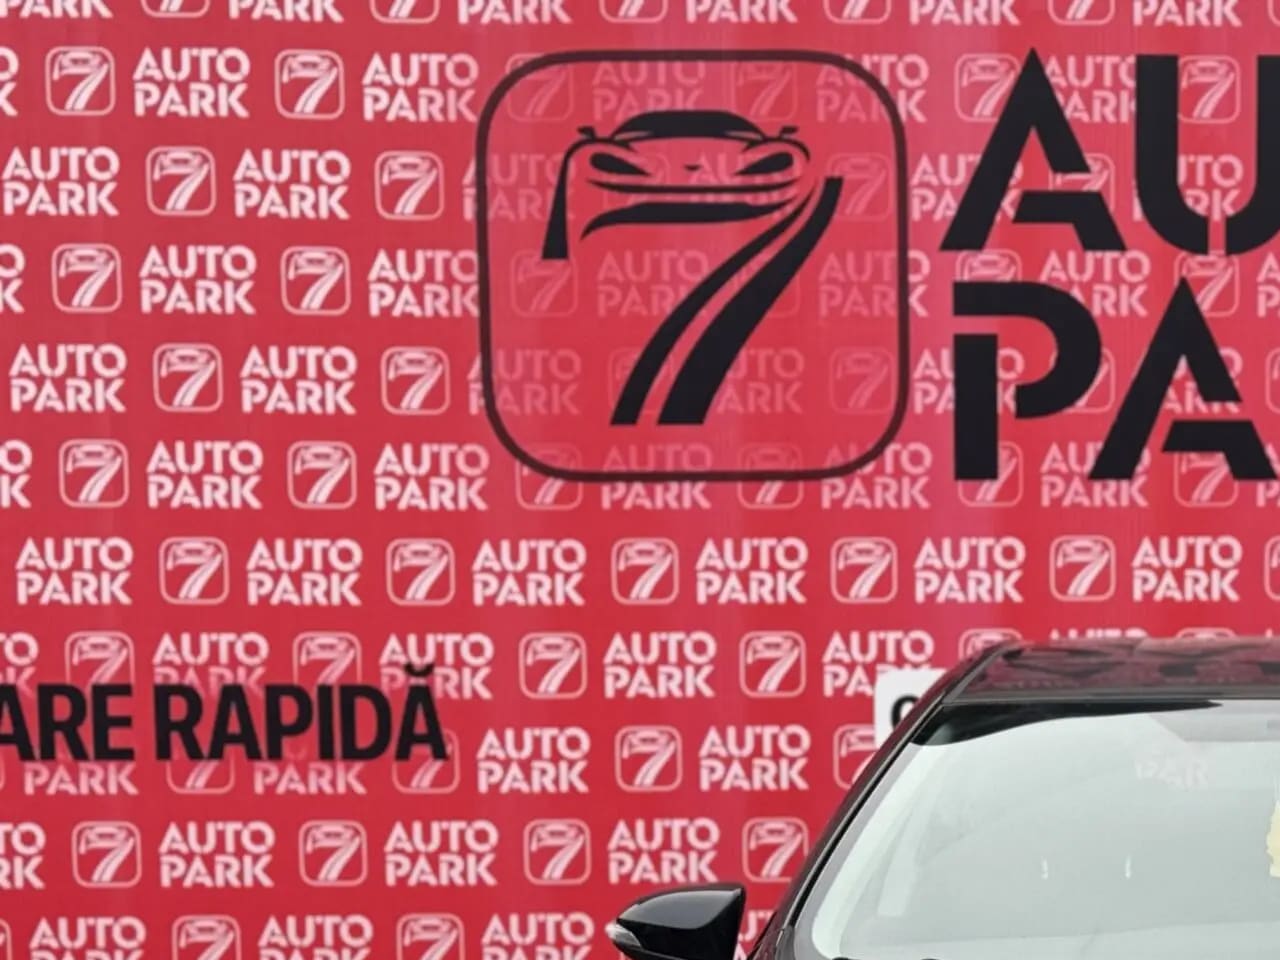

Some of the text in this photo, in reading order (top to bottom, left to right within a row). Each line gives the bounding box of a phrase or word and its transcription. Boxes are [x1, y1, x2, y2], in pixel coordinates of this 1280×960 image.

[133, 47, 250, 82] AUTO
[362, 53, 479, 87] AUTO
[134, 81, 249, 118] PARK
[363, 86, 477, 122] PARK
[1, 146, 120, 181] AUTO
[233, 148, 351, 184] AUTO
[3, 180, 119, 216] PARK
[235, 183, 349, 220] PARK
[139, 245, 257, 279] AUTO
[1040, 250, 1151, 283] AUTO
[141, 278, 256, 315] PARK
[9, 343, 127, 378] AUTO
[240, 346, 357, 380] AUTO
[10, 377, 126, 413] PARK
[241, 379, 356, 415] PARK
[146, 440, 263, 475] AUTO
[374, 443, 489, 477] AUTO
[148, 474, 262, 509] PARK
[375, 476, 488, 511] PARK
[15, 537, 133, 571] AUTO
[246, 538, 363, 572] AUTO
[472, 539, 586, 572] AUTO
[695, 537, 808, 571] AUTO
[913, 536, 1026, 570] AUTO
[1131, 535, 1243, 569] AUTO
[17, 570, 132, 605] PARK
[248, 571, 361, 606] PARK
[473, 571, 584, 606] PARK
[696, 570, 806, 604] PARK
[915, 569, 1023, 604] PARK
[1133, 568, 1239, 602] PARK
[379, 632, 494, 667] AUTO
[603, 631, 717, 665] AUTO
[605, 664, 714, 698] PARK
[154, 662, 448, 761] RAPIDĂ
[477, 727, 590, 760] AUTO
[699, 724, 811, 758] AUTO
[478, 759, 588, 794] PARK
[700, 757, 808, 791] PARK
[159, 821, 275, 854] AUTO
[384, 820, 499, 853] AUTO
[608, 817, 720, 851] AUTO
[160, 853, 273, 888] PARK
[386, 852, 497, 886] PARK
[609, 850, 718, 884] PARK
[30, 916, 146, 950] AUTO
[258, 915, 373, 948] AUTO
[482, 912, 594, 945] AUTO
